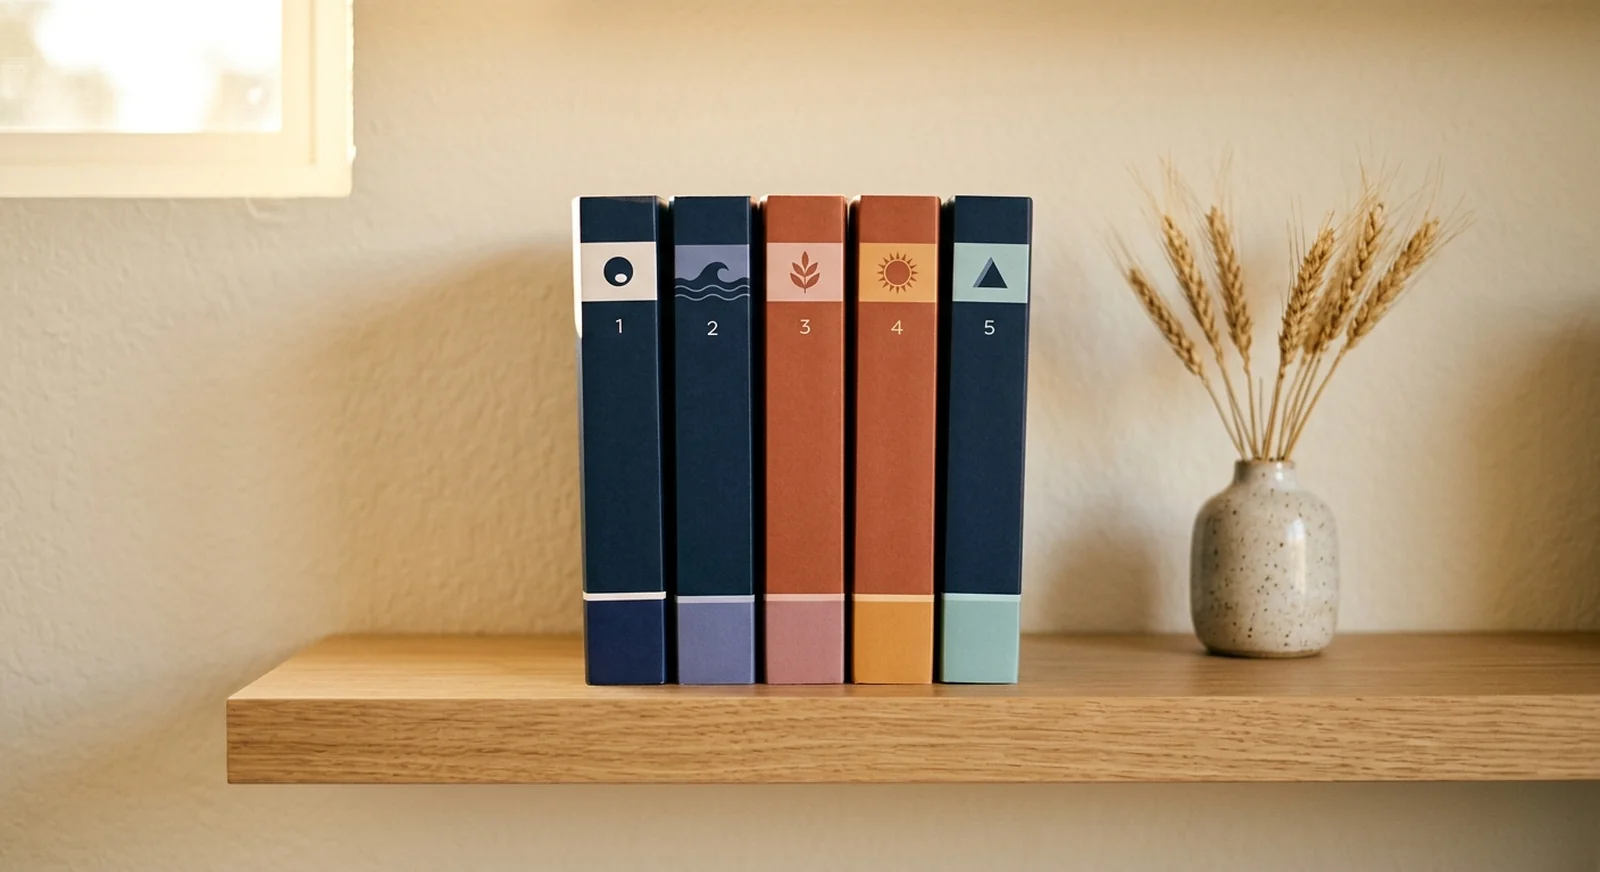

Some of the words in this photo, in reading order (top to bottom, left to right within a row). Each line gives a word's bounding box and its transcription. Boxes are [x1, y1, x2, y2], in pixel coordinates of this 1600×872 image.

[614, 318, 623, 334] 1
[707, 320, 718, 336] 2
[799, 319, 811, 335] 3
[890, 319, 904, 335] 4
[984, 319, 995, 336] 5
